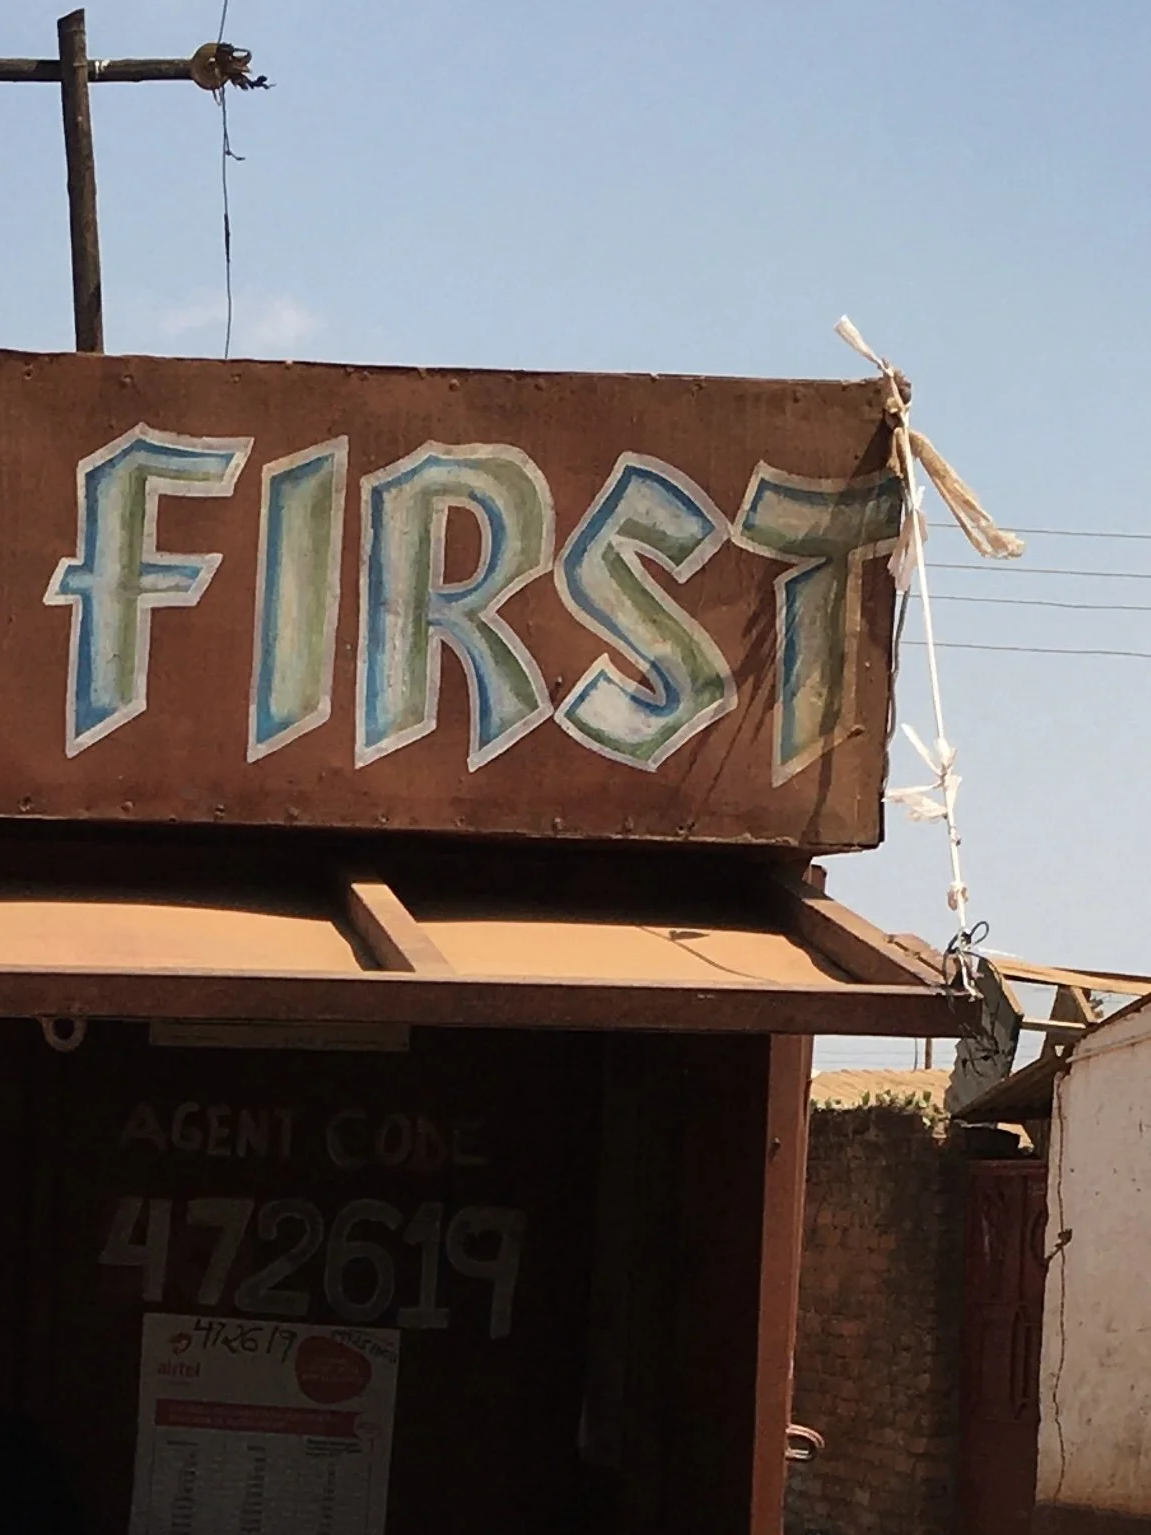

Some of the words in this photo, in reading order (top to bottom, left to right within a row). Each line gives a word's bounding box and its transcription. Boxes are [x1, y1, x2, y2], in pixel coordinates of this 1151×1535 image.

[43, 422, 902, 789] FIRST
[120, 1101, 303, 1158] AGENT
[326, 1109, 489, 1171] CODE
[98, 1194, 527, 1339] 472619
